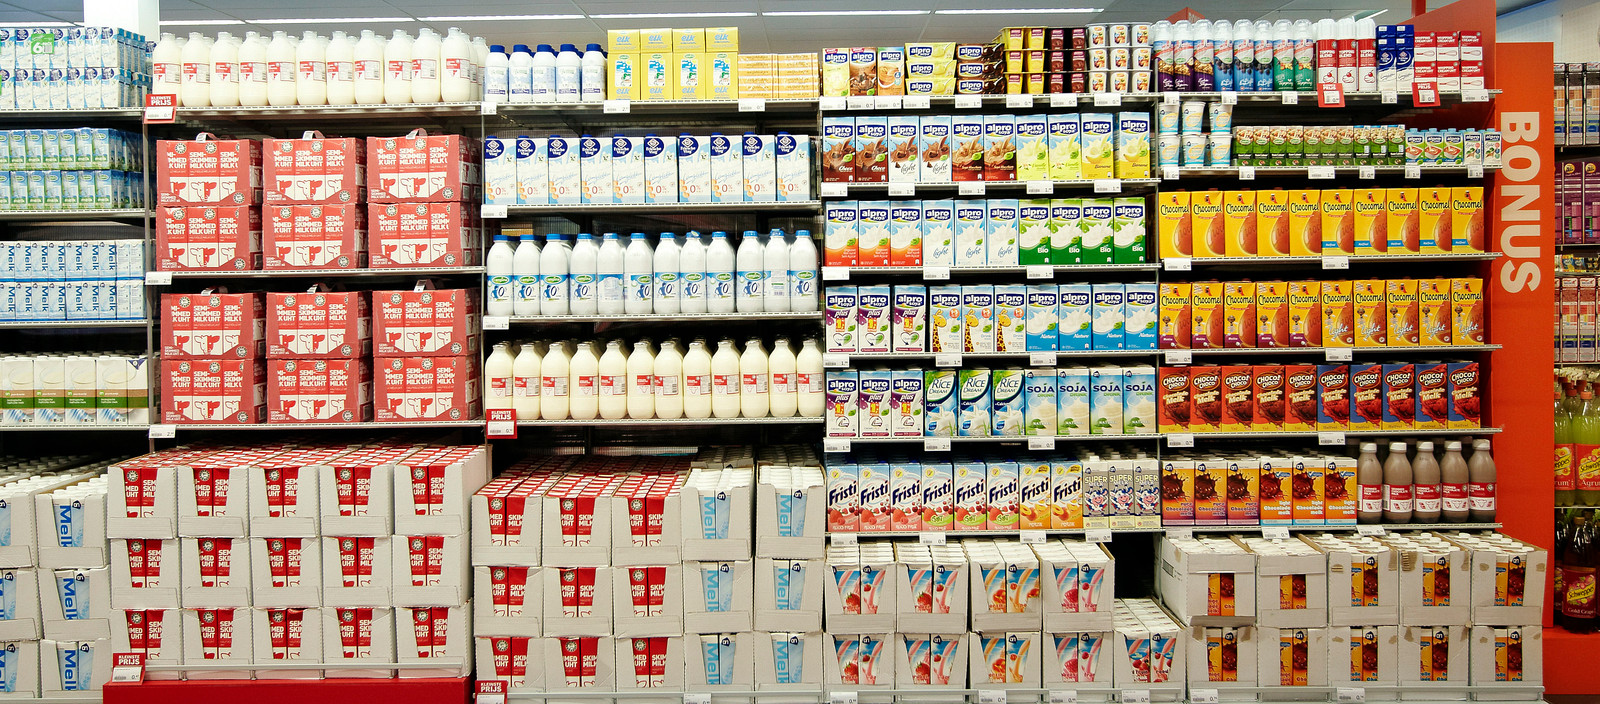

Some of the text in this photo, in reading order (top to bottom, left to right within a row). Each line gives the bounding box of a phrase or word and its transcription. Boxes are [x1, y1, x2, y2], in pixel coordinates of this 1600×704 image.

[911, 47, 931, 55] alpro
[825, 54, 846, 62] alpro
[826, 126, 851, 135] alpro
[859, 126, 883, 135] alpro
[892, 126, 914, 135] alpro
[1019, 124, 1043, 134] alpro
[1052, 123, 1076, 134] alpro
[1085, 122, 1109, 133] alpro
[1123, 121, 1146, 132] alpro
[1323, 202, 1352, 212] Chocomel
[1356, 202, 1385, 212] Chocomel
[1388, 201, 1417, 211] Chocomel
[1421, 200, 1449, 211] Chocomel
[1453, 200, 1482, 210] Chocomel
[1501, 112, 1541, 293] BONUS
[1085, 208, 1110, 218] alpro
[1117, 207, 1141, 217] alpro
[1161, 204, 1189, 215] Chocomel
[1194, 204, 1222, 214] Chocomel
[1226, 204, 1254, 214] Chocomel
[1259, 203, 1287, 214] Chocomel
[1291, 203, 1319, 213] Chocomel
[830, 210, 854, 220] alpro
[862, 210, 886, 220] alpro
[893, 210, 918, 220] alpro
[959, 210, 982, 219] alpro
[1022, 209, 1047, 219] alpro
[1054, 209, 1078, 219] alpro
[829, 297, 853, 306] alpro
[861, 297, 886, 306] alpro
[897, 296, 922, 306] alpro
[933, 296, 958, 306] alpro
[998, 295, 1023, 305] alpro
[1030, 294, 1055, 305] alpro
[1063, 294, 1088, 305] alpro
[1129, 294, 1154, 304] alpro
[1161, 296, 1190, 306] Chocomel
[1194, 295, 1221, 306] Chocomel
[1226, 295, 1254, 305] Chocomel
[1258, 295, 1286, 305] Chocomel
[1291, 295, 1319, 305] Chocomel
[1323, 294, 1351, 304] Chocomel
[1356, 293, 1384, 303] Chocomel
[1388, 293, 1417, 303] Chocomel
[1421, 292, 1449, 302] Chocomel
[1453, 292, 1482, 302] Chocomel
[1163, 376, 1186, 386] CHOCO!
[1194, 376, 1218, 386] CHOCO!
[1226, 375, 1249, 385] CHOCO!
[1257, 375, 1280, 385] CHOCO!
[1321, 374, 1344, 384] CHOCO!
[1354, 374, 1378, 383] CHOCO!
[1387, 373, 1410, 383] CHOCO!
[1419, 373, 1443, 382] CHOCO!
[1425, 378, 1441, 386] CHOCO
[830, 381, 854, 391] alpro
[863, 381, 888, 391] alpro
[895, 381, 920, 391] alpro
[1126, 384, 1153, 392] SOJA
[1169, 381, 1184, 389] CHOCO
[1200, 381, 1215, 389] CHOCO
[1231, 381, 1247, 389] CHOCO
[1326, 379, 1343, 387] CHOCO
[1359, 379, 1376, 387] CHOCO
[1392, 379, 1408, 387] CHOCO
[1166, 396, 1184, 404] Melk
[1422, 393, 1441, 401] Melk
[1085, 476, 1107, 484] SUPER
[829, 481, 856, 506] Fristi
[861, 480, 888, 506] Fristi
[892, 480, 919, 506] Fristi
[924, 479, 951, 505] Fristi
[957, 479, 984, 504] Fristi
[989, 479, 1016, 503] Fristi
[1022, 477, 1049, 503] Fristi
[1054, 477, 1081, 502] Fristi
